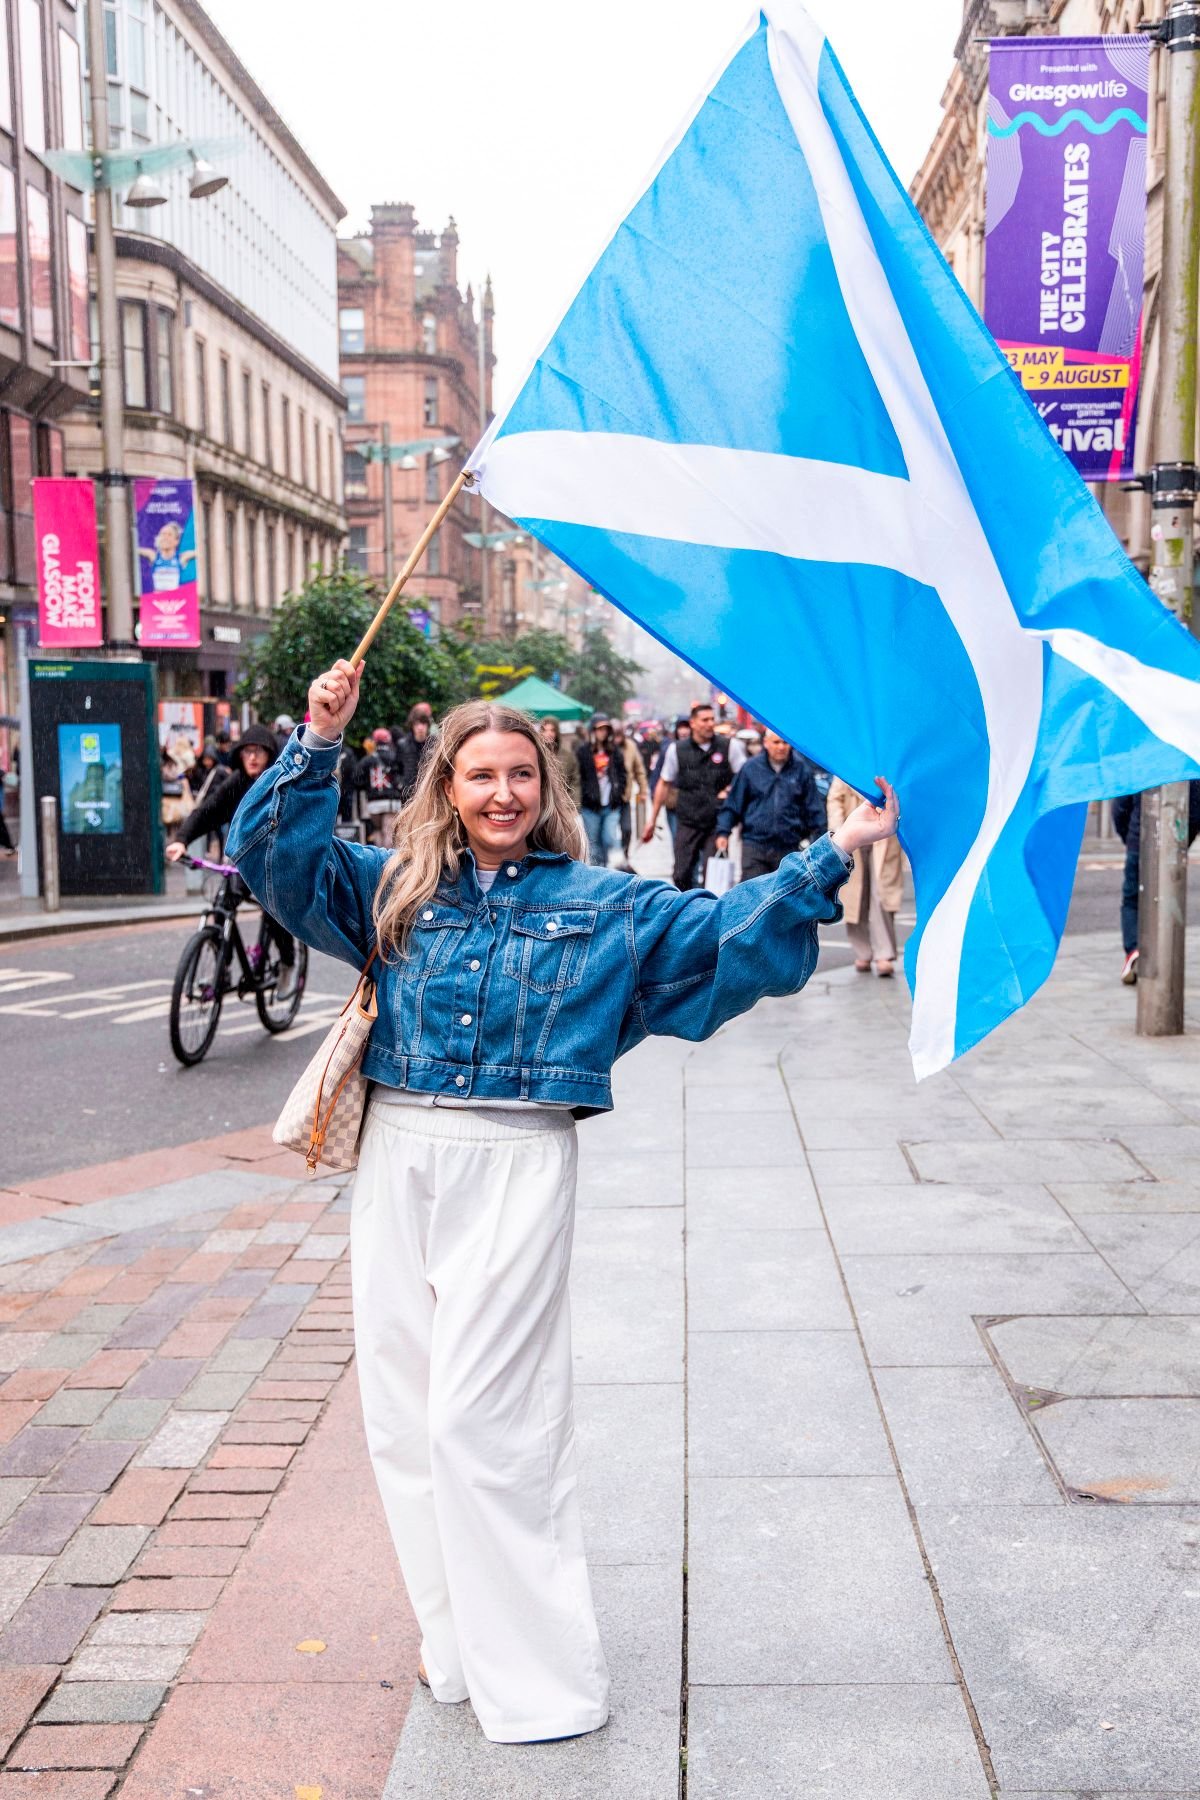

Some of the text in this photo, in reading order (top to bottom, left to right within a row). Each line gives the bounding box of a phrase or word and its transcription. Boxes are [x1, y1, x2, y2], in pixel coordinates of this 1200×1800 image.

[1040, 62, 1098, 73] Presented with
[1060, 142, 1090, 333] CELEBRATES
[1039, 231, 1061, 335] THE CITY
[1004, 351, 1059, 366] 3 MAY
[1040, 371, 1049, 384] 9
[1053, 369, 1123, 384] AUGUST
[41, 533, 64, 628] GLASGOW
[61, 575, 79, 628] MAKE
[76, 560, 96, 628] PEOPLE
